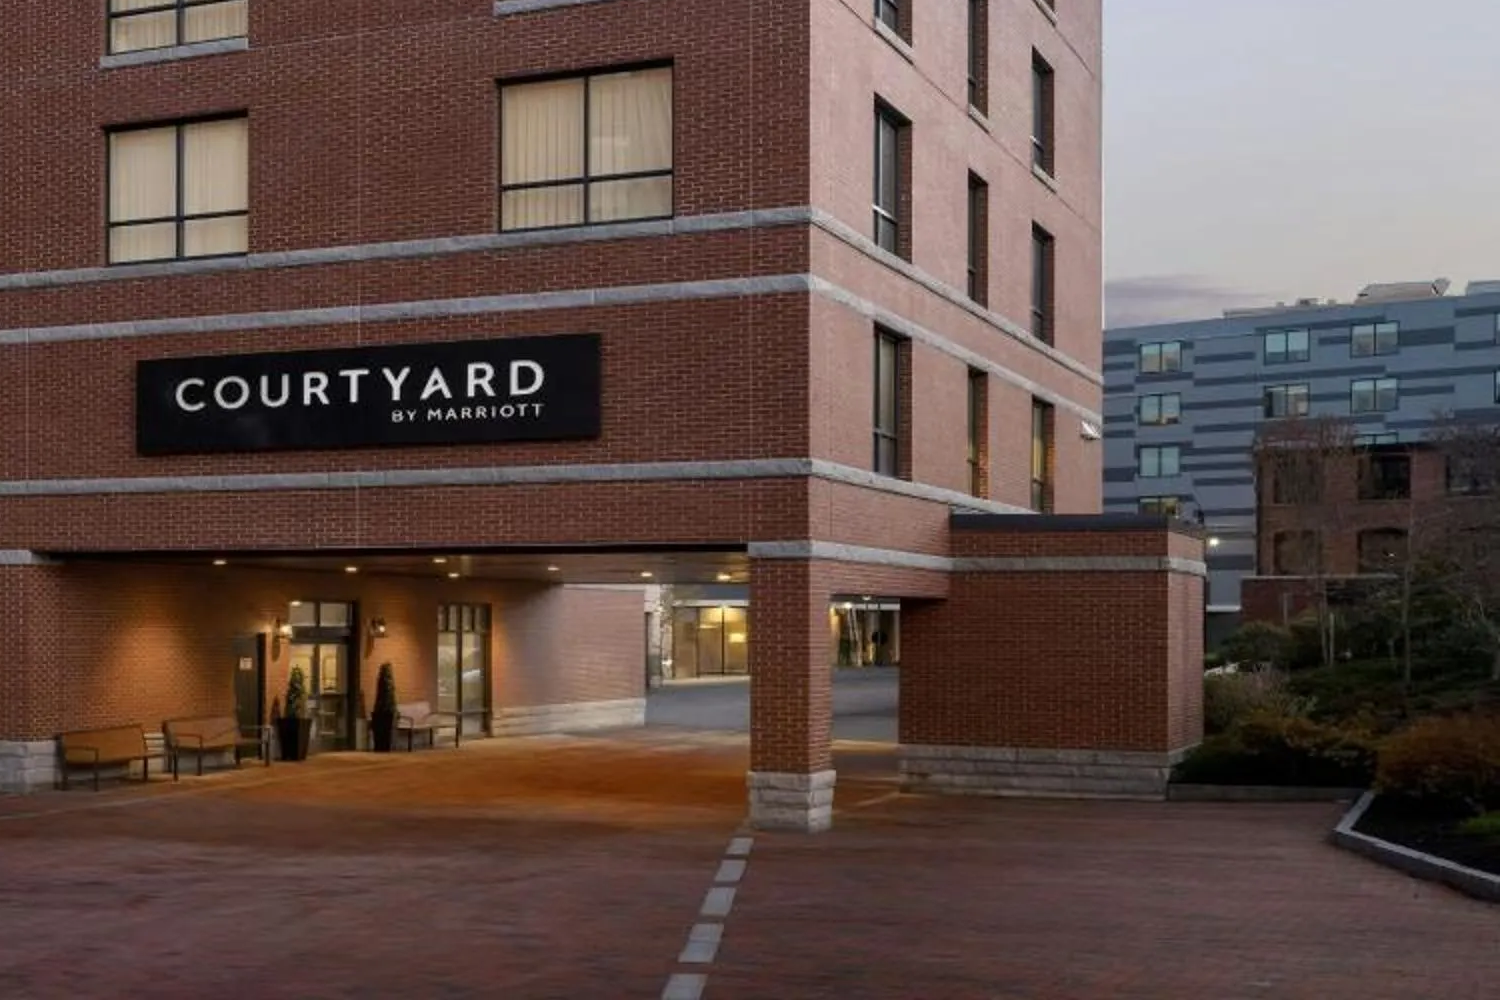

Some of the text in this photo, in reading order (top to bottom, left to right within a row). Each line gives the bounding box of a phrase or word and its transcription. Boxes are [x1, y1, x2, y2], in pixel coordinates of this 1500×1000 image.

[174, 359, 545, 412] COURTYARD
[391, 403, 546, 423] BY MARRIOTT
